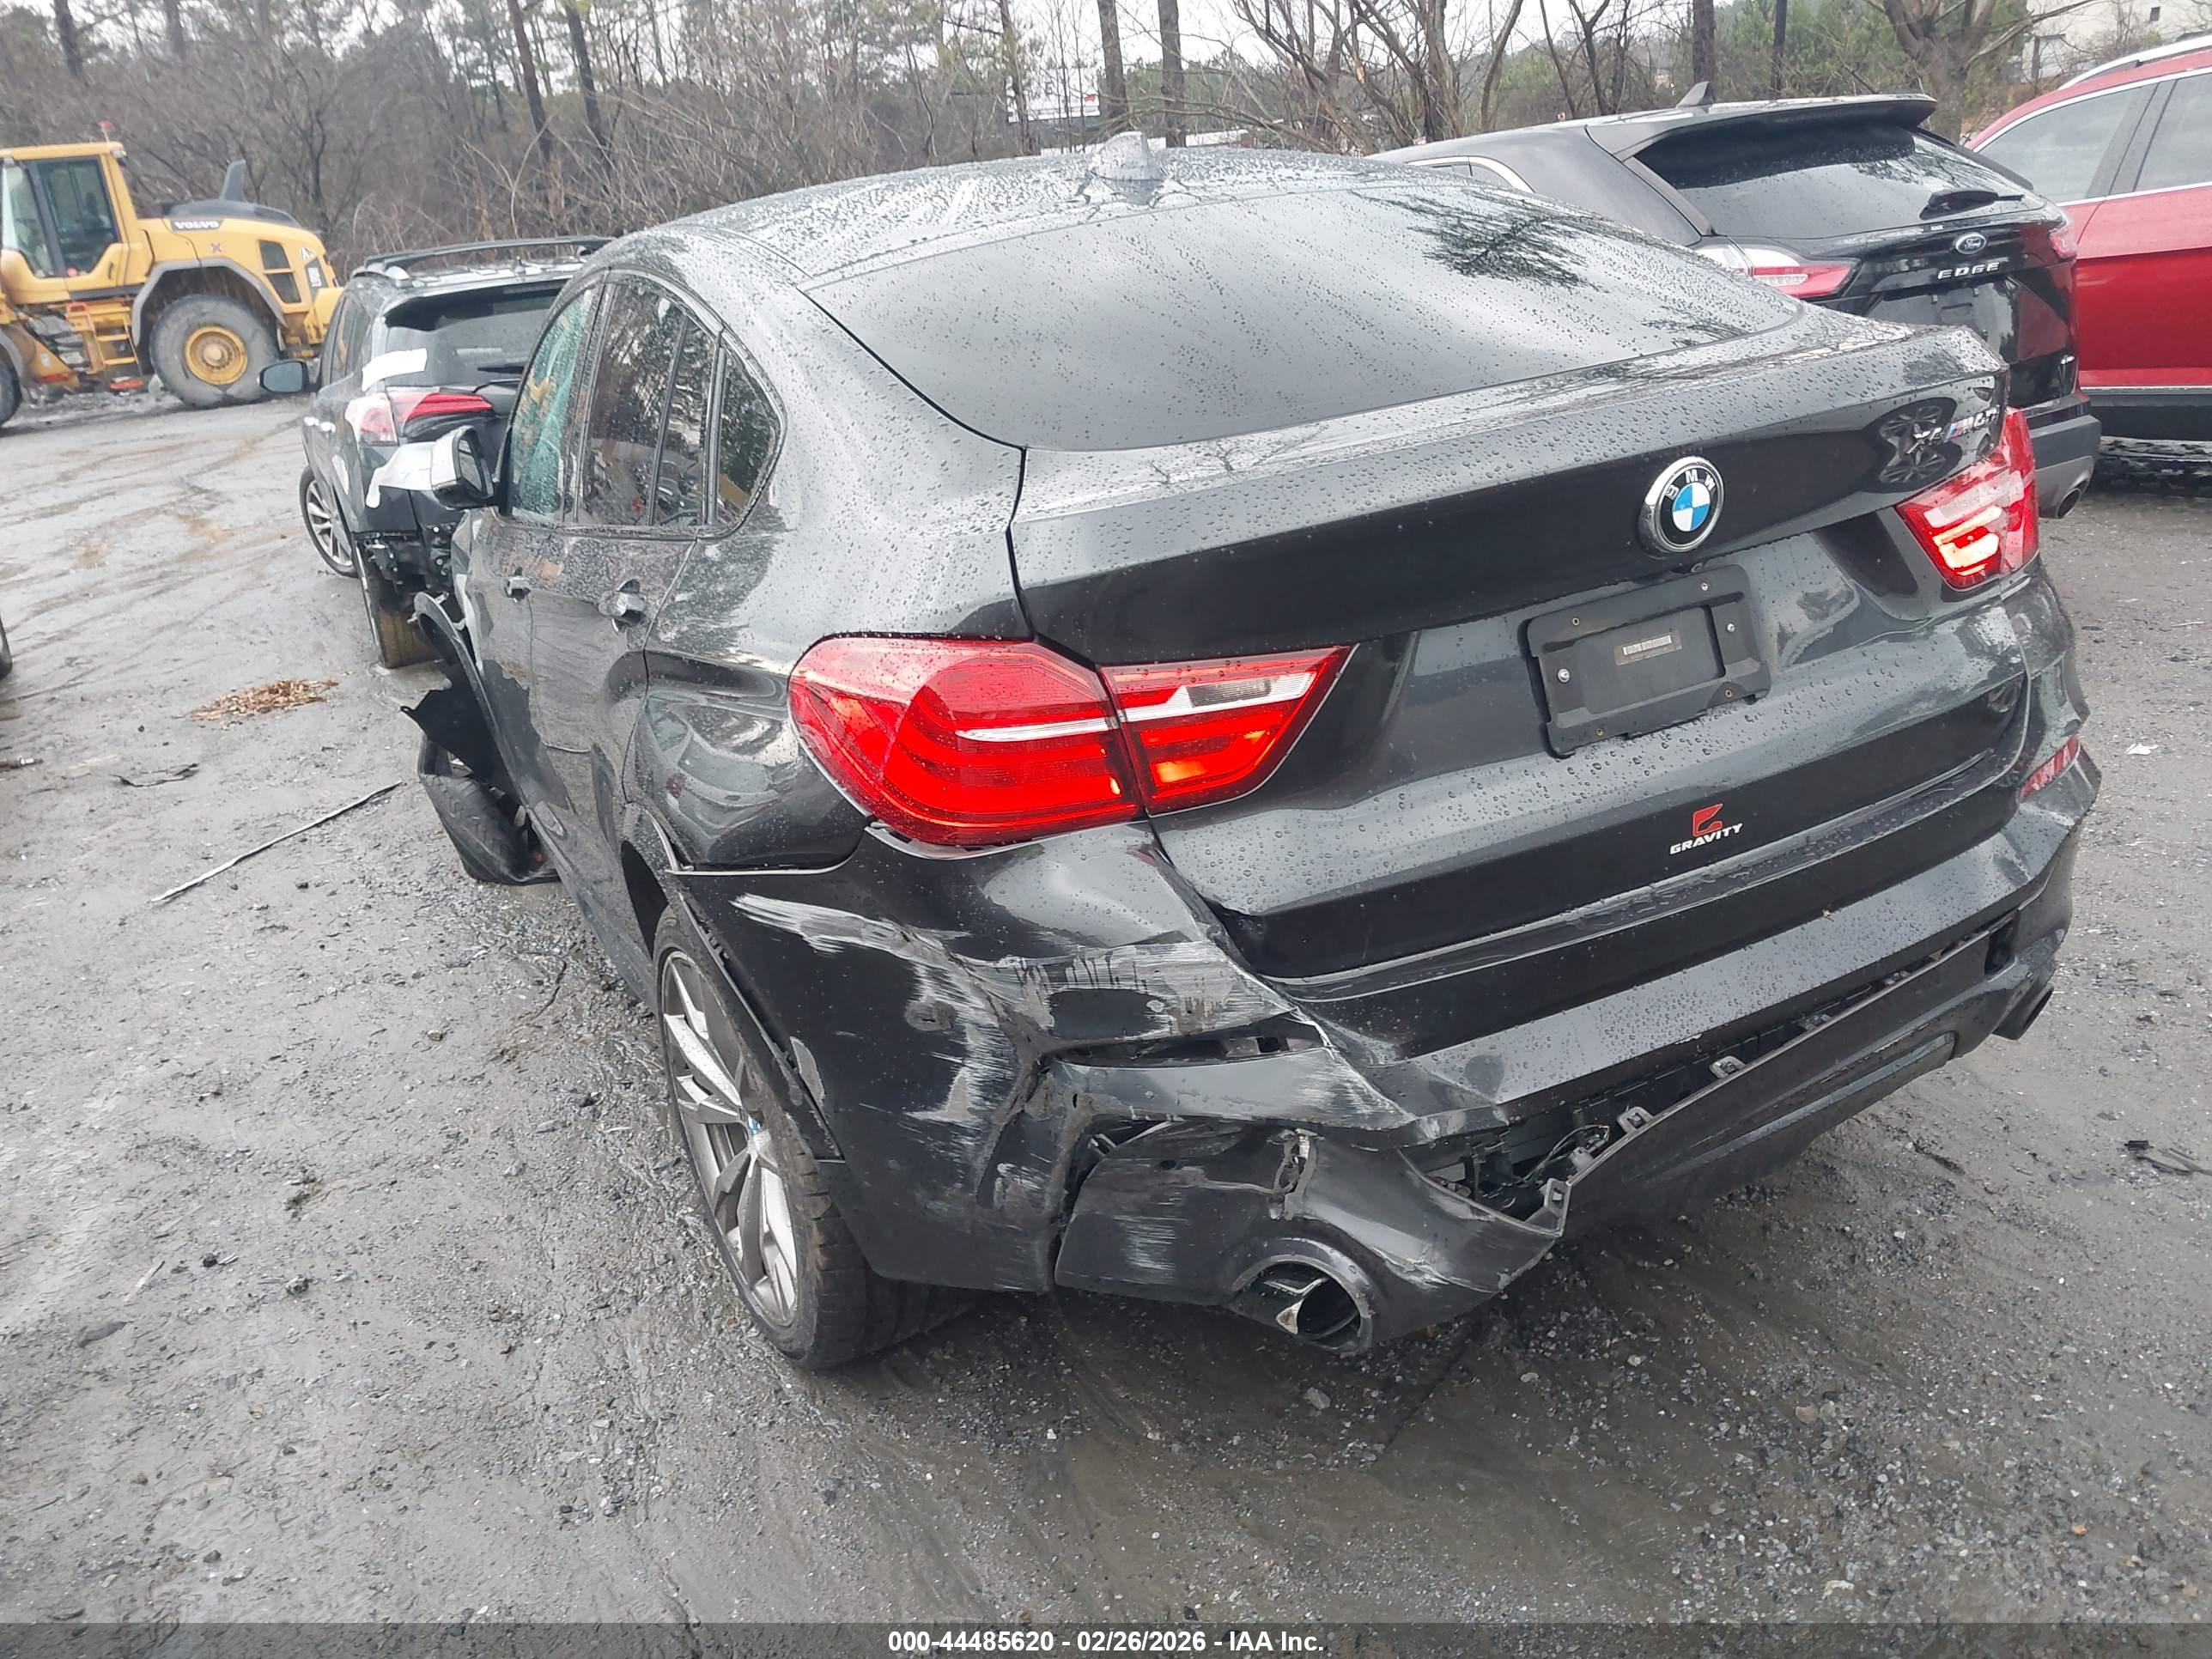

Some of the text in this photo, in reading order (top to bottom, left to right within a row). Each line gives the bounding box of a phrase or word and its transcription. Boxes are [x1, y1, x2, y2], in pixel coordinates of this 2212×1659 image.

[174, 221, 220, 229] VOLVO
[1937, 262, 2000, 280] EDGE
[1665, 469, 1716, 501] BMW
[1669, 823, 1743, 855] GRAVITY
